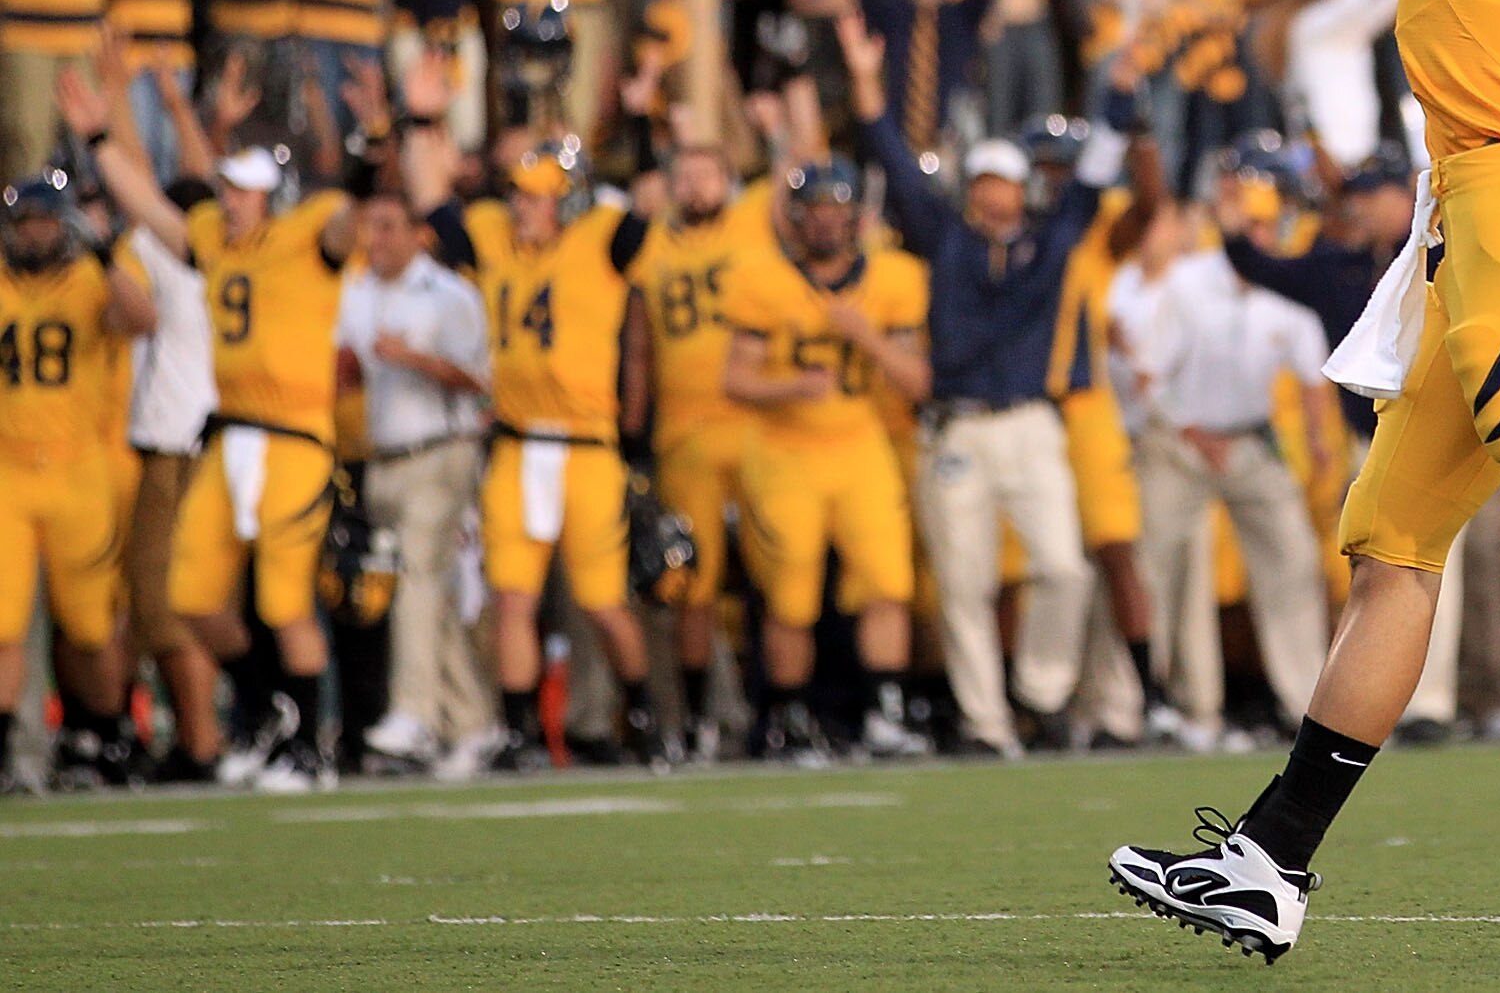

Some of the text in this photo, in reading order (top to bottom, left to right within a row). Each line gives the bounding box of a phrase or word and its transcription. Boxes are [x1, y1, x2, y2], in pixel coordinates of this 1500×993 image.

[221, 274, 252, 345] 9
[497, 280, 554, 349] 14
[0, 321, 73, 387] 48
